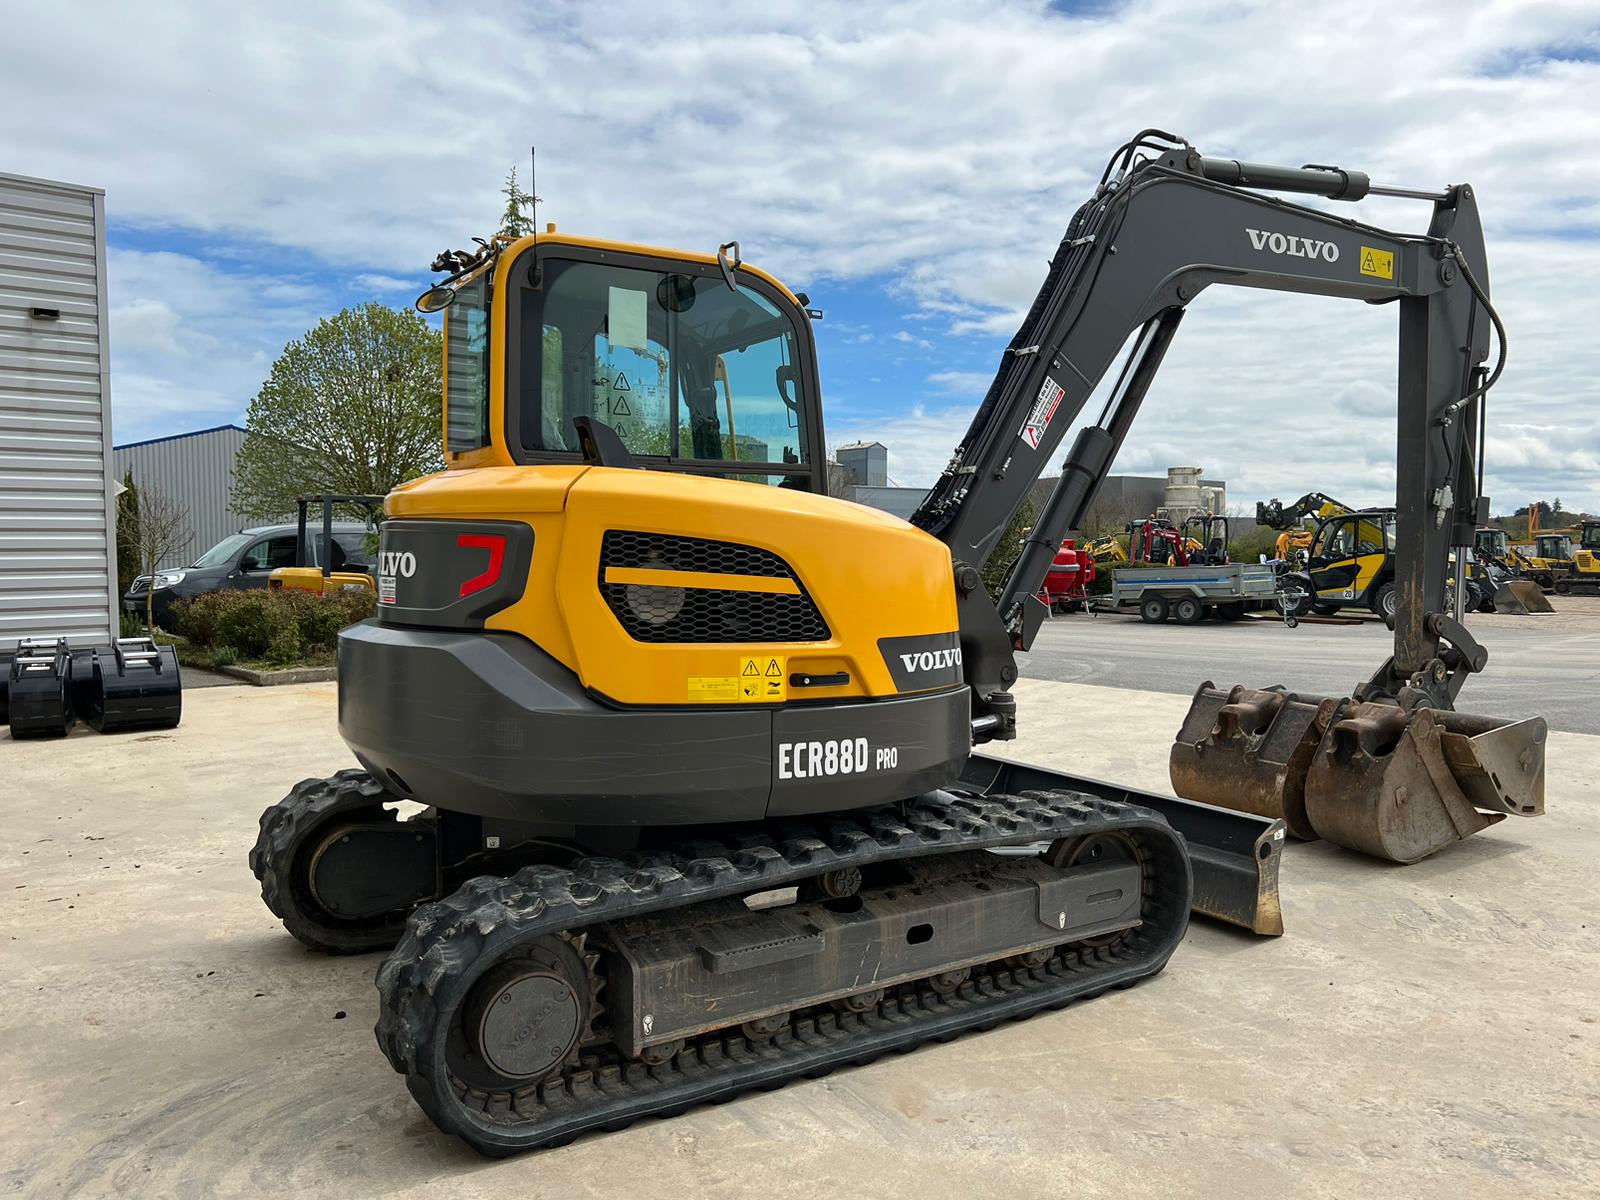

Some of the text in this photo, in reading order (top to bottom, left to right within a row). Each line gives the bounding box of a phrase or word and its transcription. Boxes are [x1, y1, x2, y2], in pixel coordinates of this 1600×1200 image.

[1246, 228, 1339, 262] VOLVO
[378, 551, 416, 578] LVO
[1344, 589, 1352, 598] 20
[900, 648, 962, 673] VOLVO
[779, 737, 898, 779] ECR88D PRO
